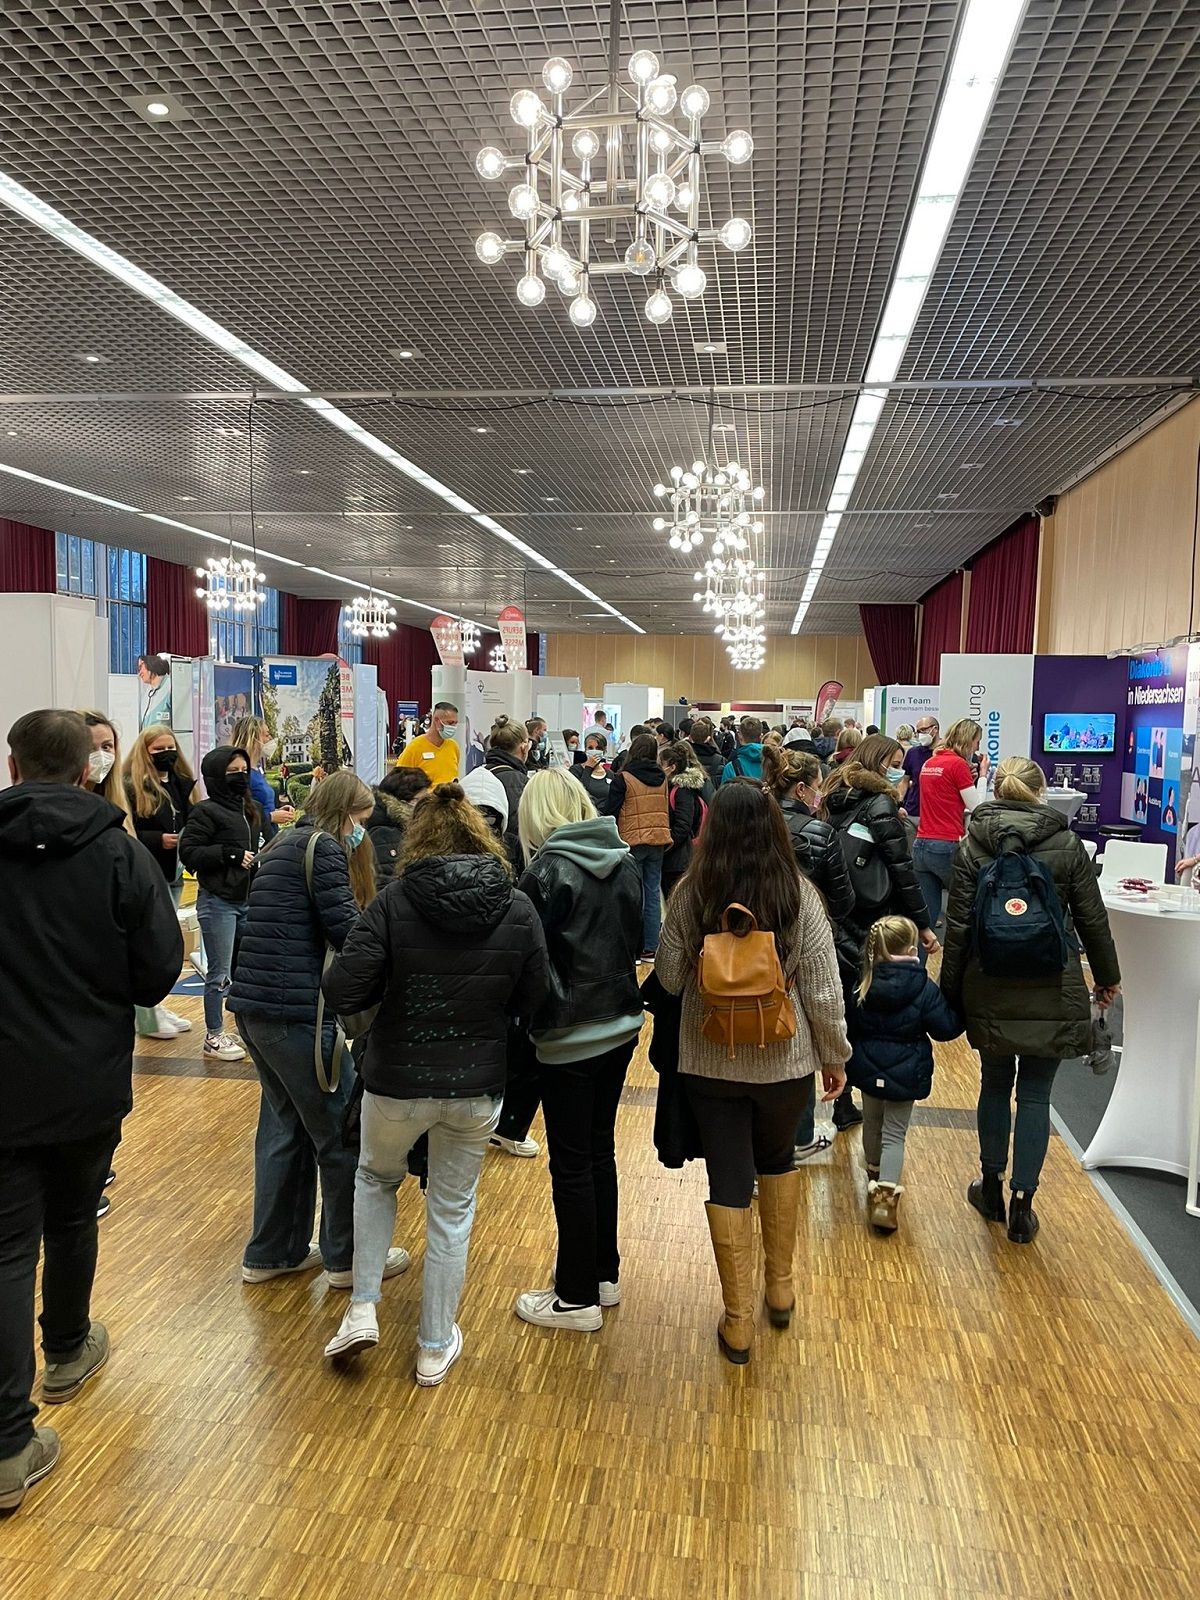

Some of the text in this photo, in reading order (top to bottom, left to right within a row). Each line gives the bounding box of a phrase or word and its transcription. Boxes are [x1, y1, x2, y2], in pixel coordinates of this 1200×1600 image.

[1129, 658, 1164, 680] Diakonie
[1127, 686, 1134, 705] in
[1134, 682, 1184, 705] Niedersachsen
